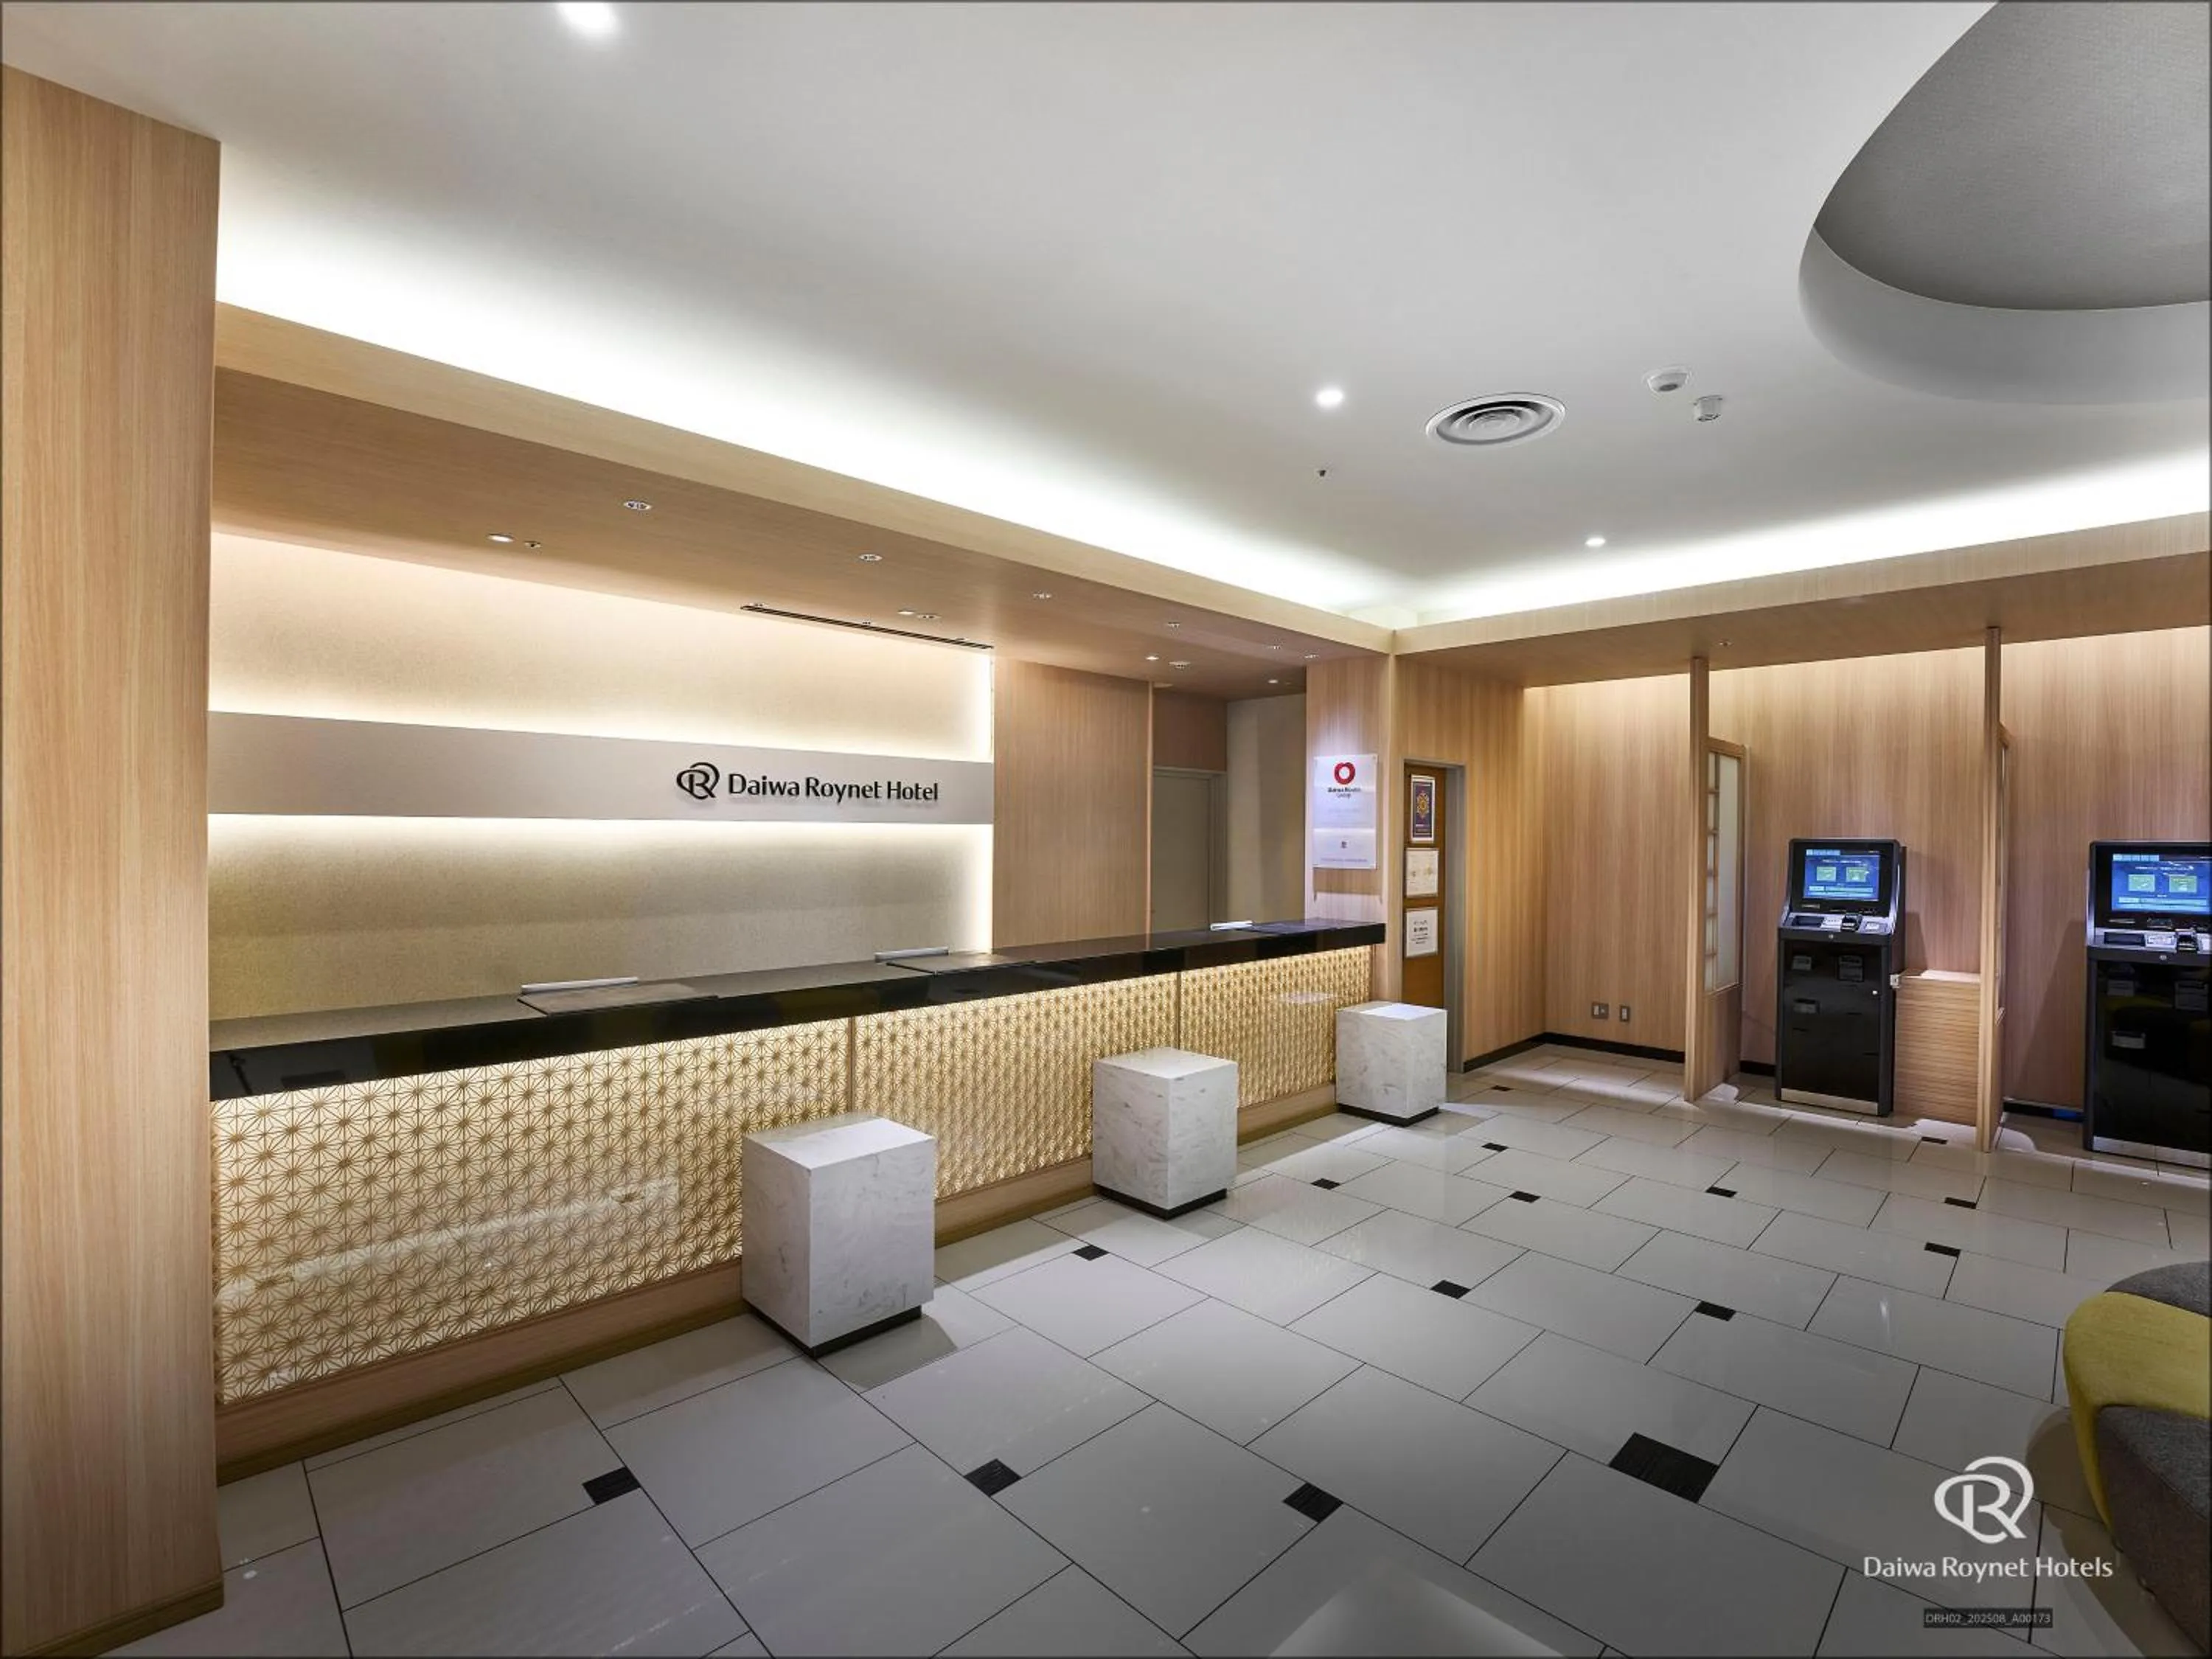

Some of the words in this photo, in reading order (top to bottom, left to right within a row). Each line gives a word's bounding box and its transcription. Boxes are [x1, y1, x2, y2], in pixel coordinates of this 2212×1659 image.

[728, 773, 799, 796] Daiwa
[805, 776, 882, 802] Roynet
[887, 782, 939, 801] Hotel
